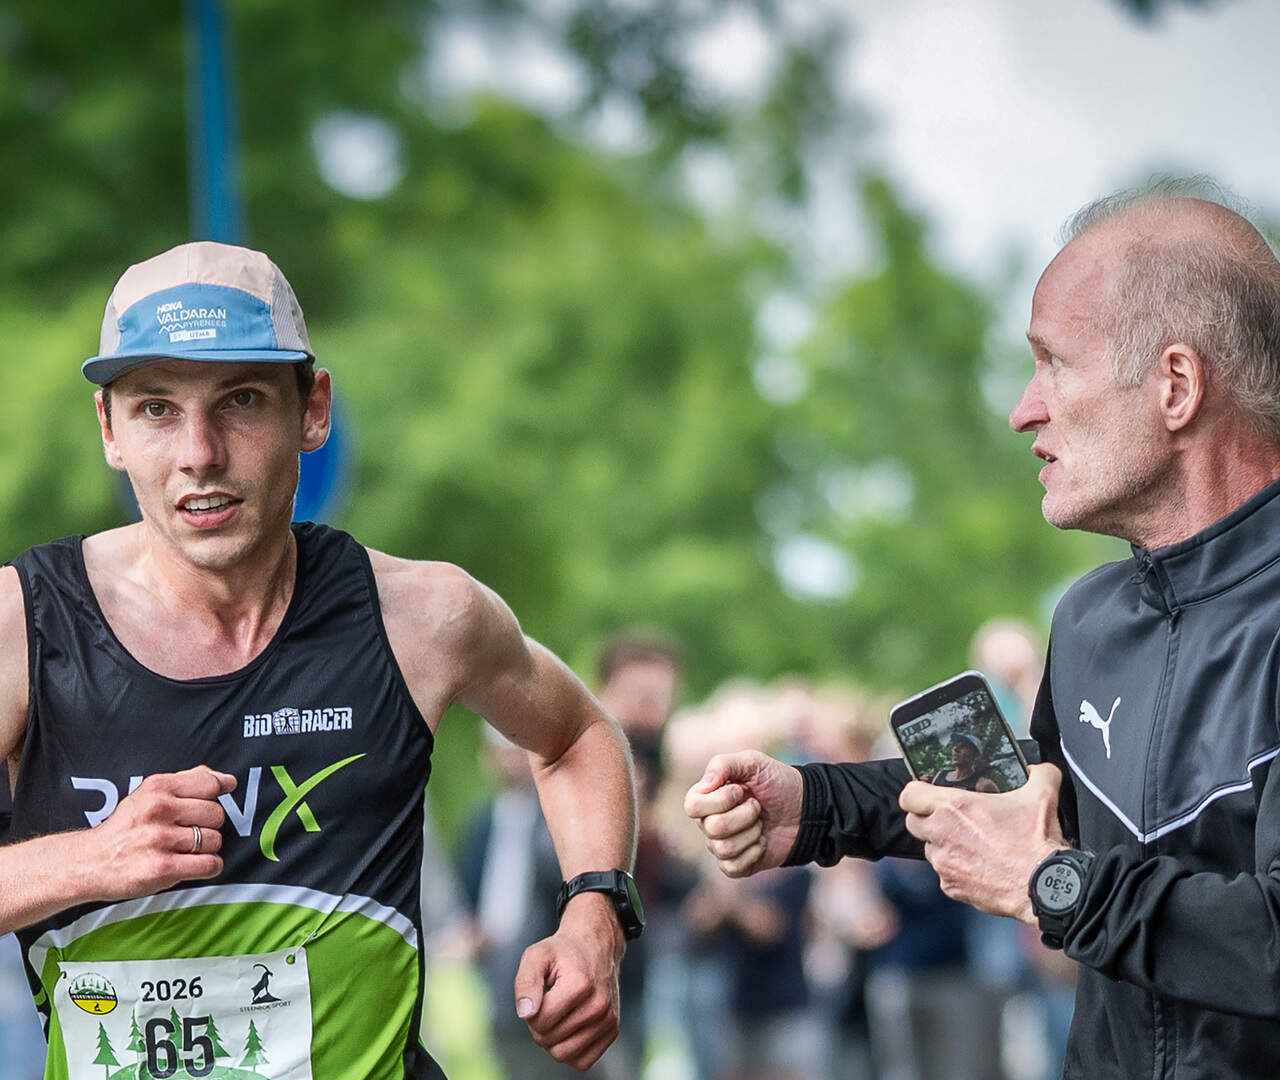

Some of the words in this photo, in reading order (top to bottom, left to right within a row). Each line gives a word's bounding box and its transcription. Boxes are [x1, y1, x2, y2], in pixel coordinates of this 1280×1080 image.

[301, 707, 352, 732] RACER
[1044, 875, 1073, 894] 5:30
[141, 976, 203, 1002] 2026
[145, 1016, 216, 1080] 65
